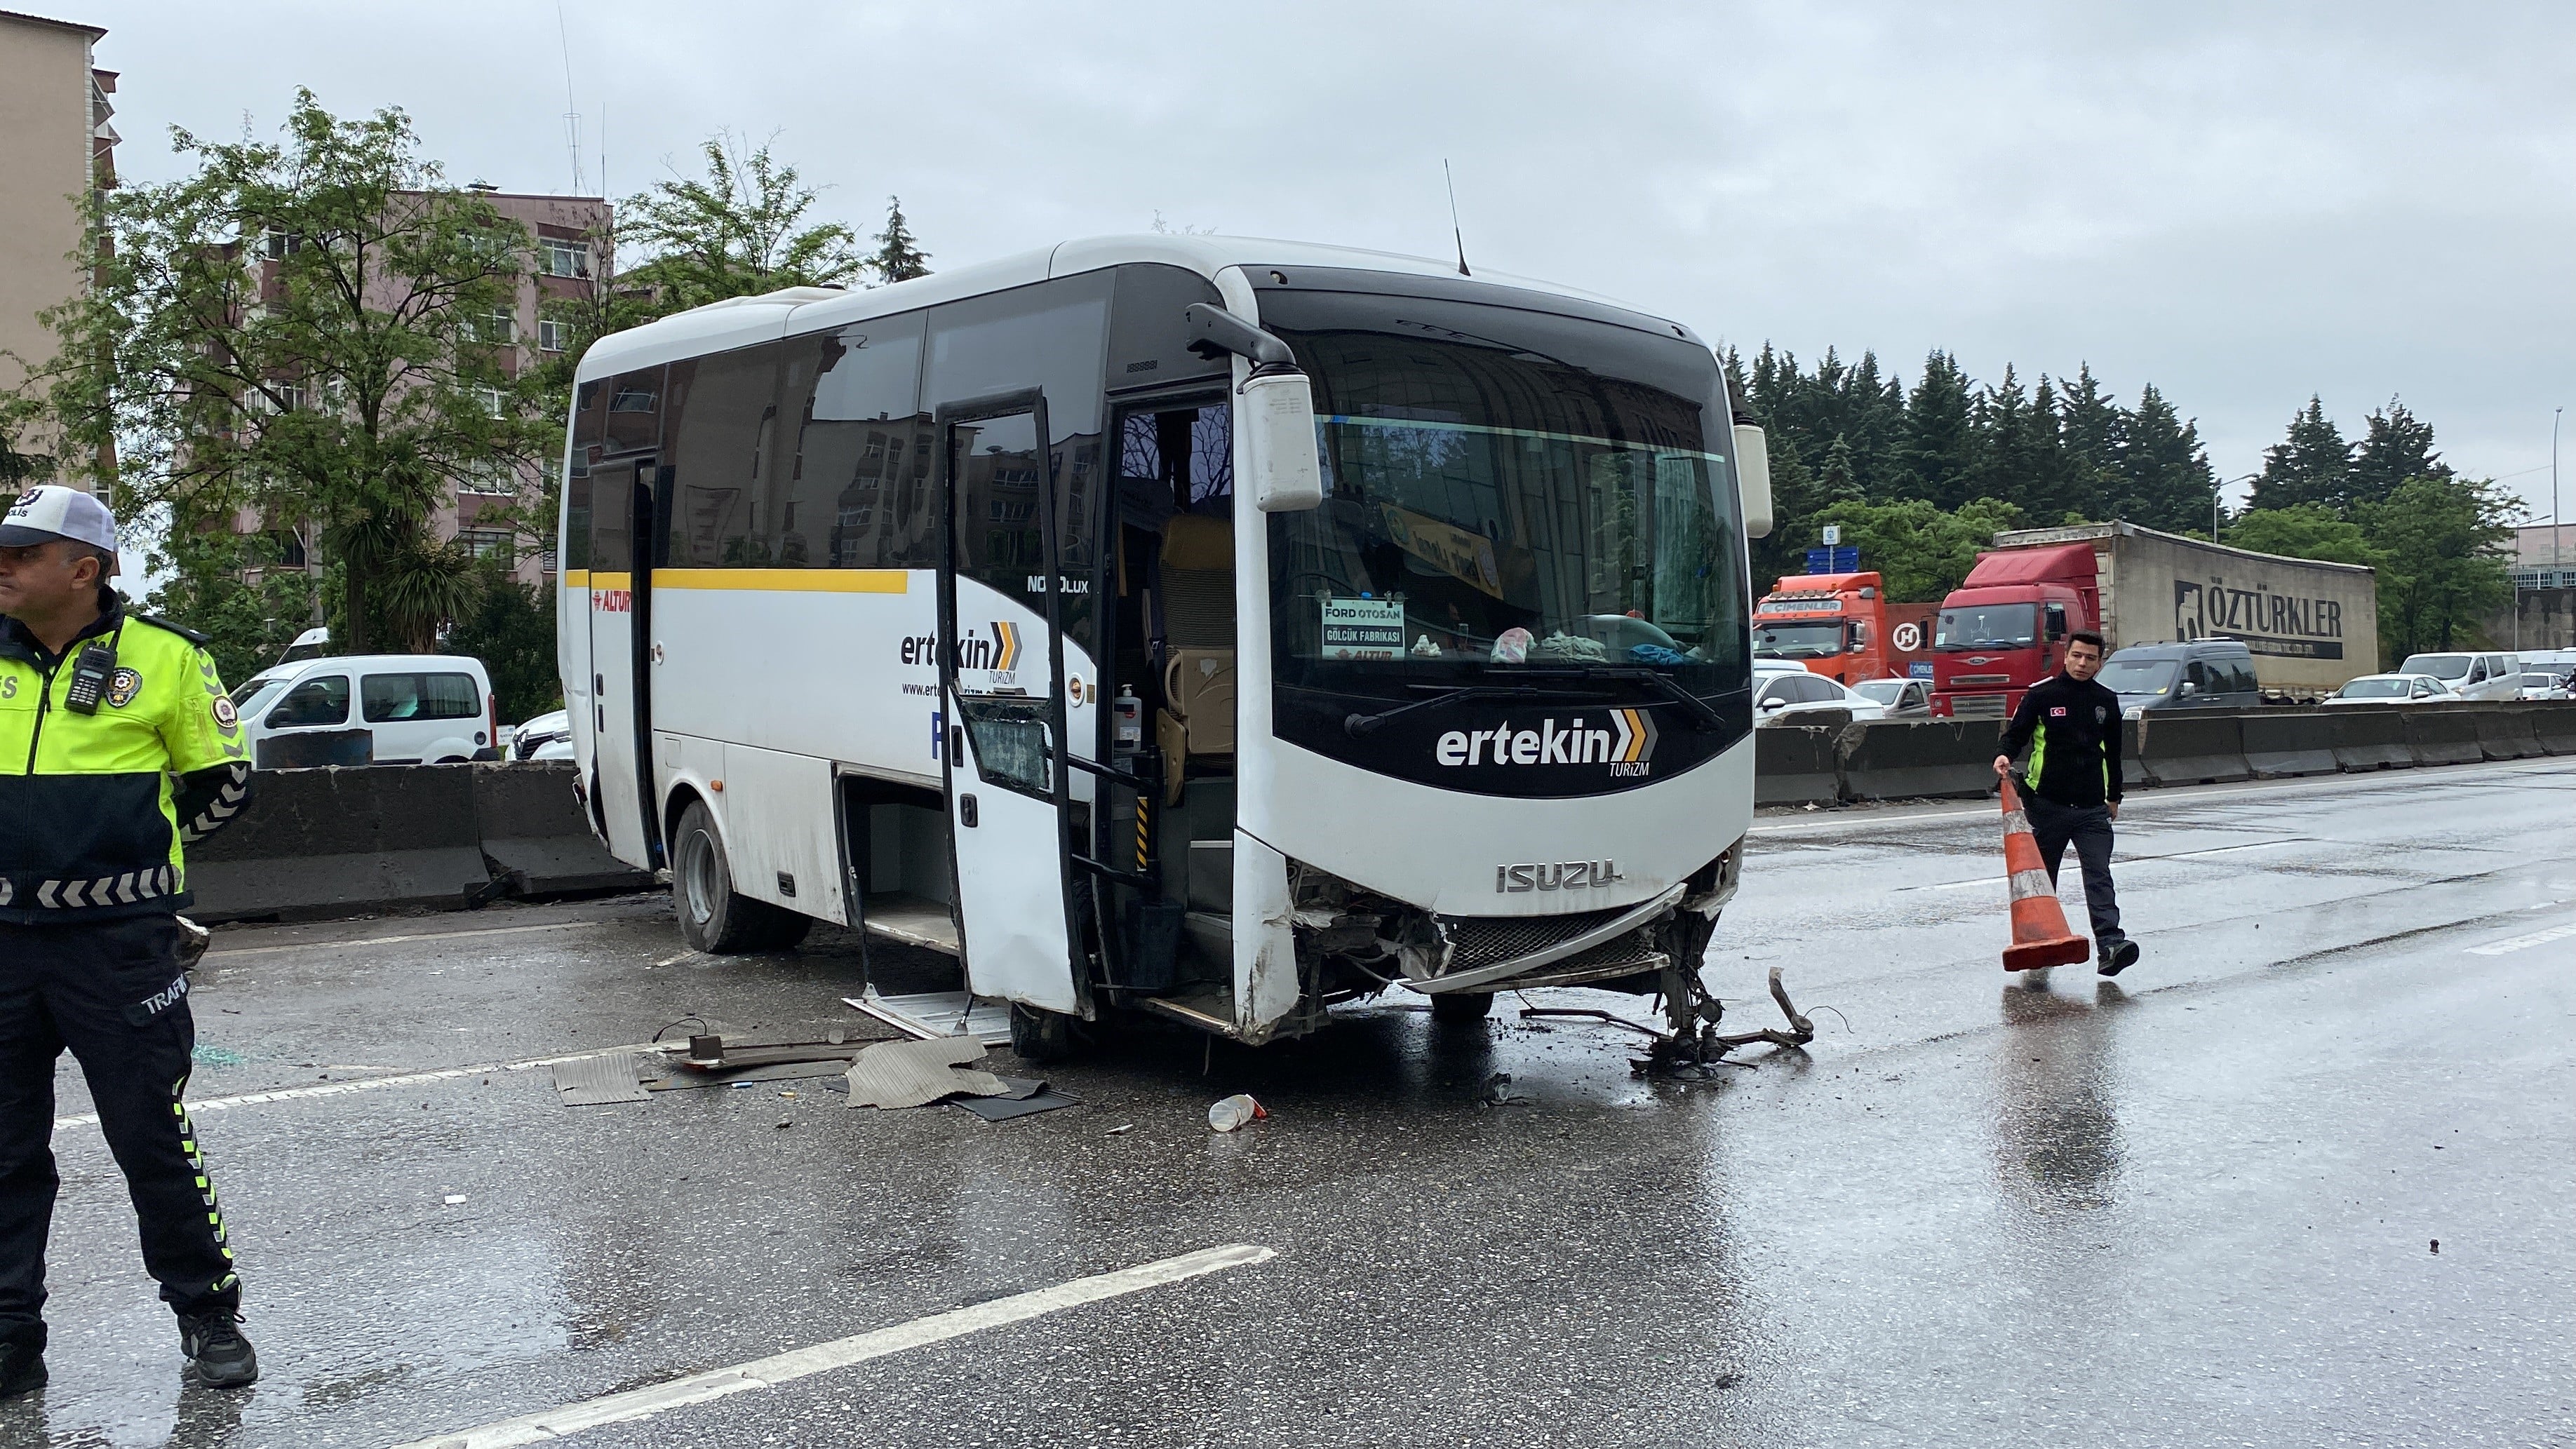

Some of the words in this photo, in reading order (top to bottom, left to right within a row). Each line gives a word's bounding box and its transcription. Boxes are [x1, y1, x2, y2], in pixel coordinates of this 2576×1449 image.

[603, 590, 631, 612] ALTUR
[1325, 608, 1356, 618] FORD
[1358, 609, 1400, 619] OTOSAN
[2210, 577, 2342, 638] ÖZTÜRKLER
[1327, 627, 1357, 642] GÖLCÜK
[1360, 628, 1400, 642] FABRİKASI
[1436, 719, 1611, 767] ertekin
[1496, 858, 1614, 894] ISUZU
